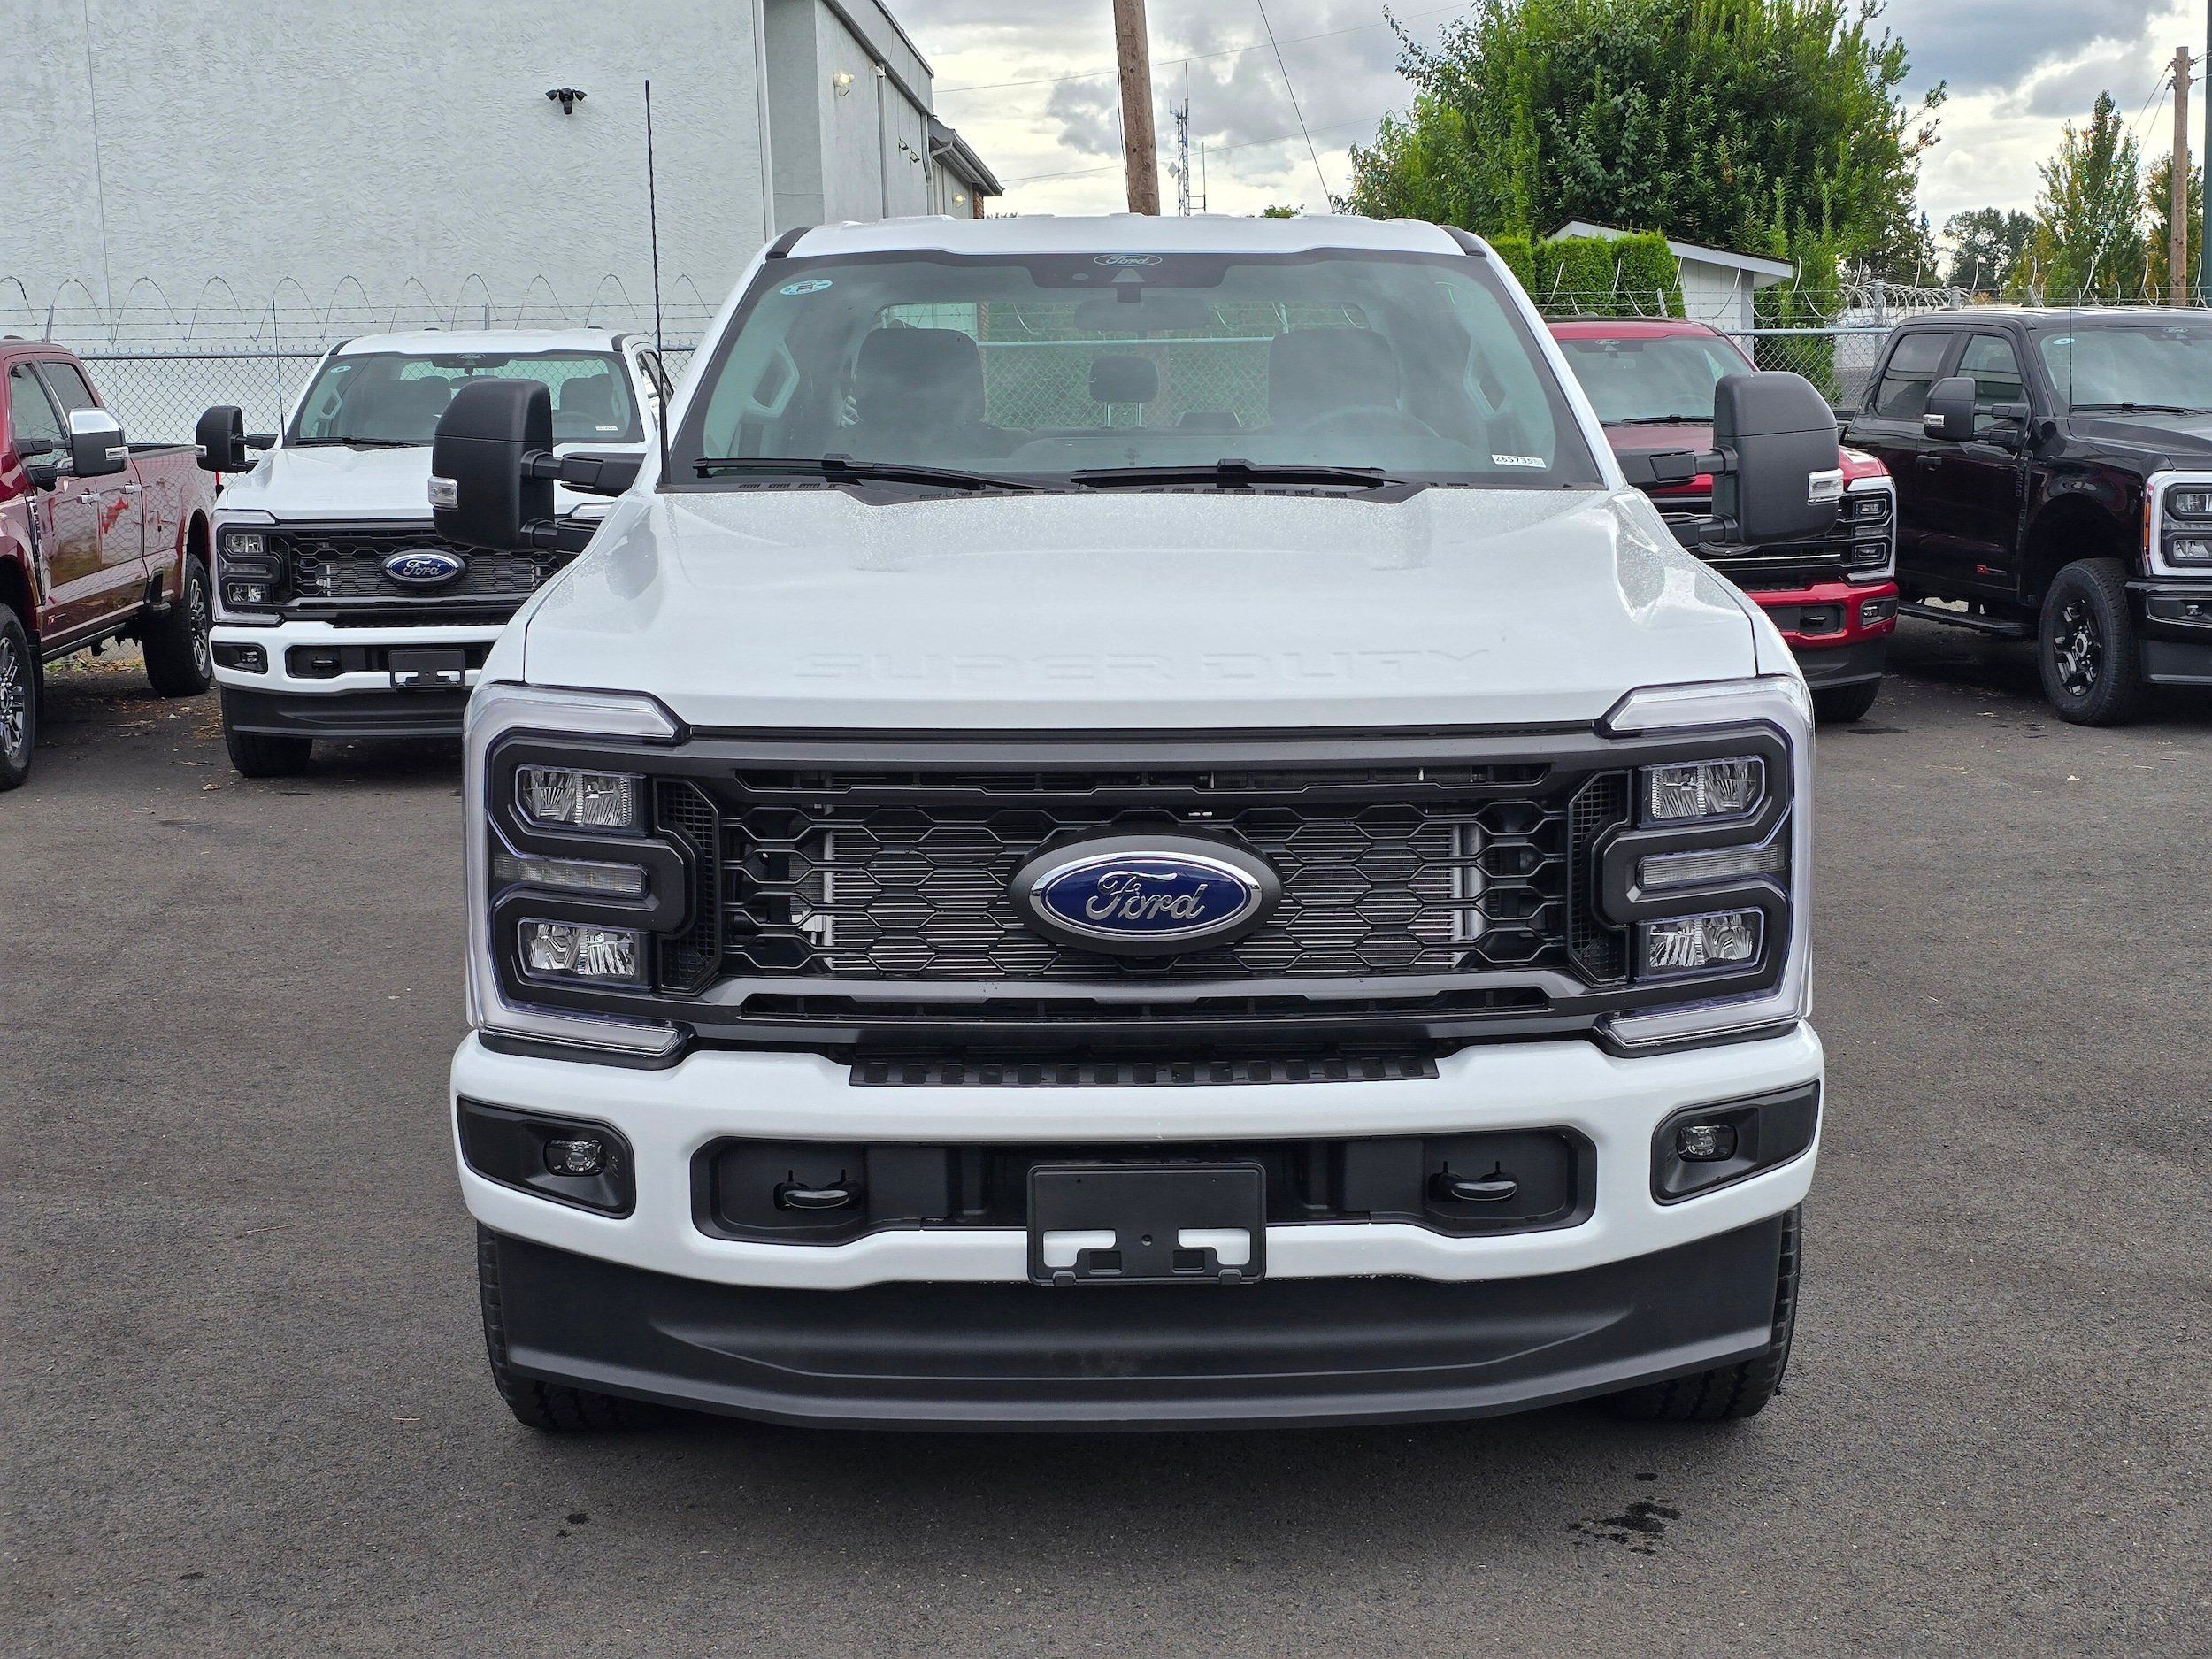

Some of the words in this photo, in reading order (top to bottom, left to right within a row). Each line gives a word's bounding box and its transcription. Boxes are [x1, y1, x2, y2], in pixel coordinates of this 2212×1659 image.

[1105, 255, 1149, 265] Ford
[403, 559, 442, 576] Ford
[794, 652, 1174, 680] SUPER
[1202, 649, 1490, 680] DUTY
[1086, 871, 1209, 920] Ford
